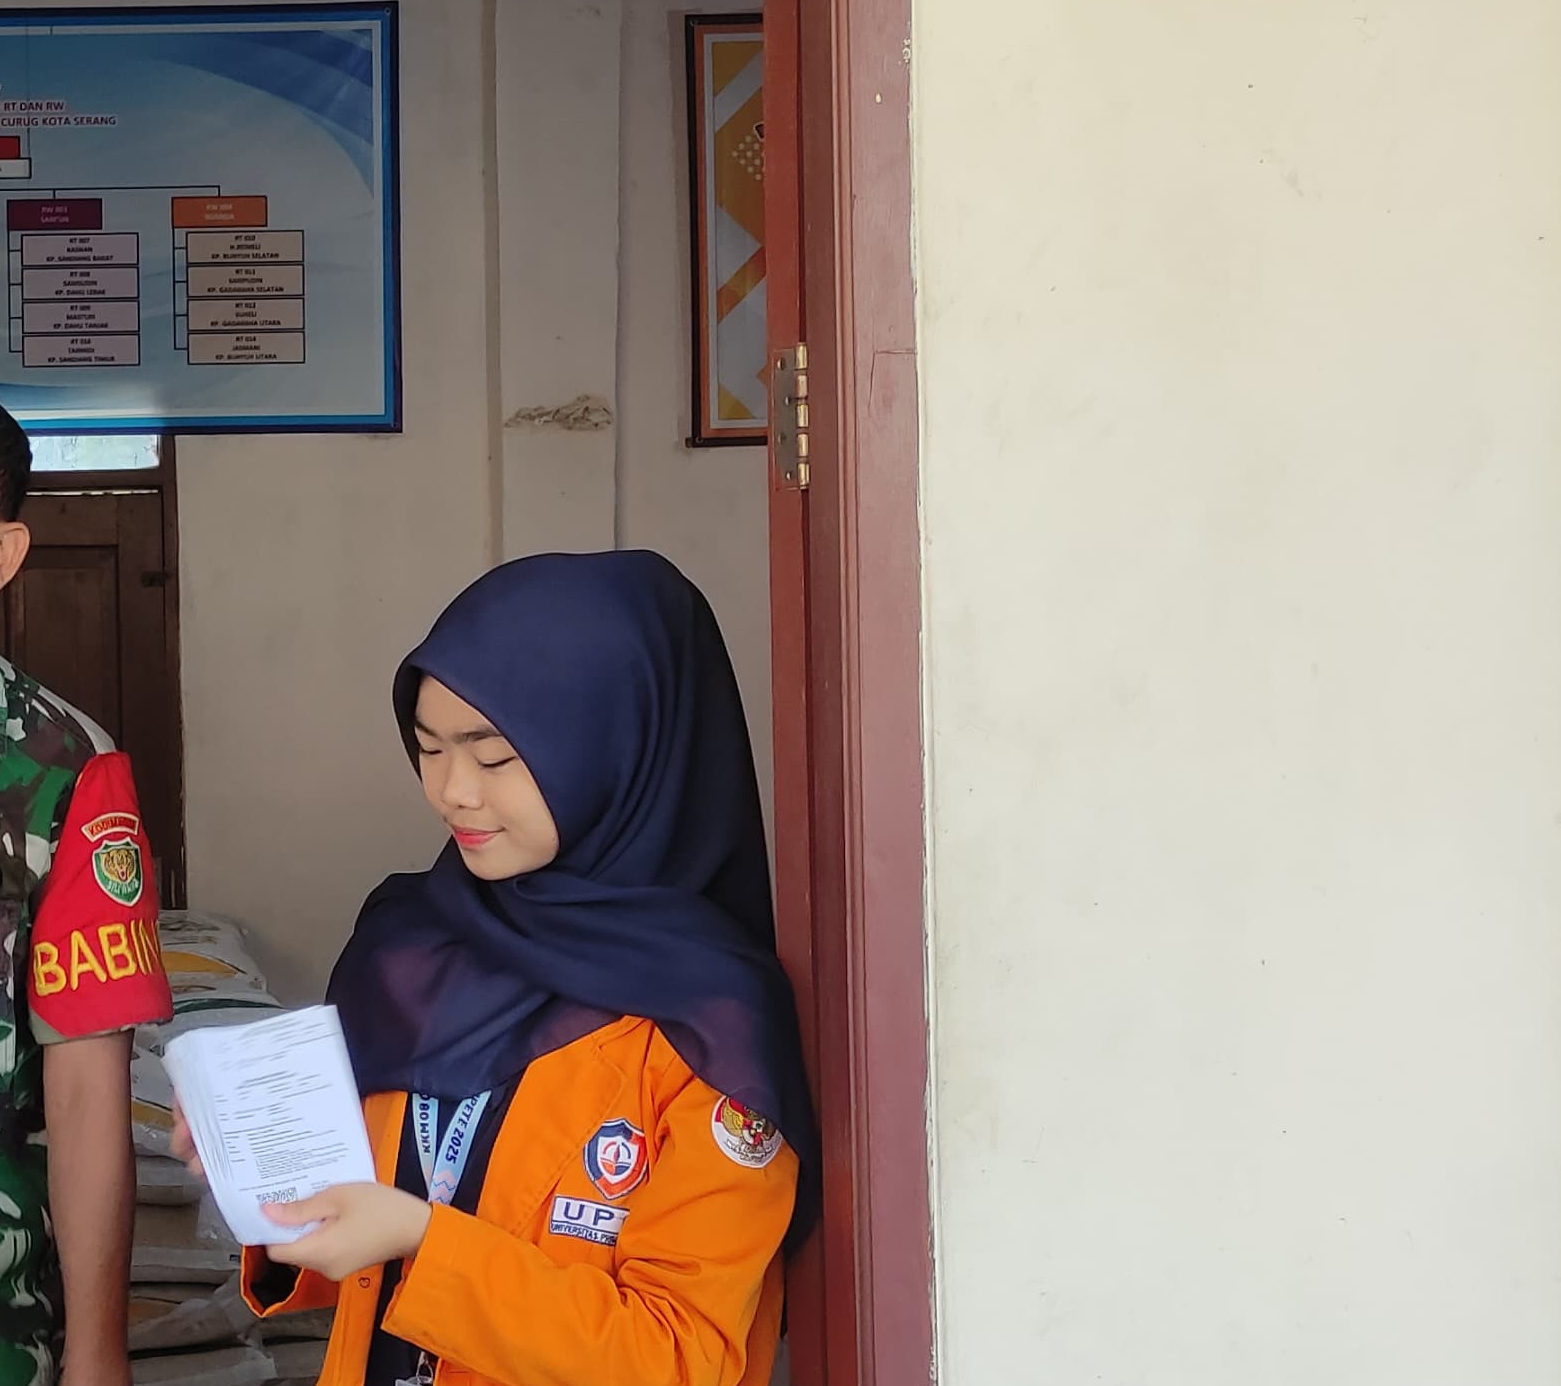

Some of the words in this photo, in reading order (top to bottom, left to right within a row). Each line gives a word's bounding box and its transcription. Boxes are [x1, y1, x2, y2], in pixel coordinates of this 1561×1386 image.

[3, 101, 17, 112] RT
[19, 101, 43, 112] DAN
[46, 101, 65, 112] RW
[0, 117, 39, 127] CURUG
[42, 116, 71, 127] KOTA
[73, 115, 116, 127] SERANG
[445, 1127, 465, 1165] 2025
[551, 1223, 598, 1240] UNIVERSITAS
